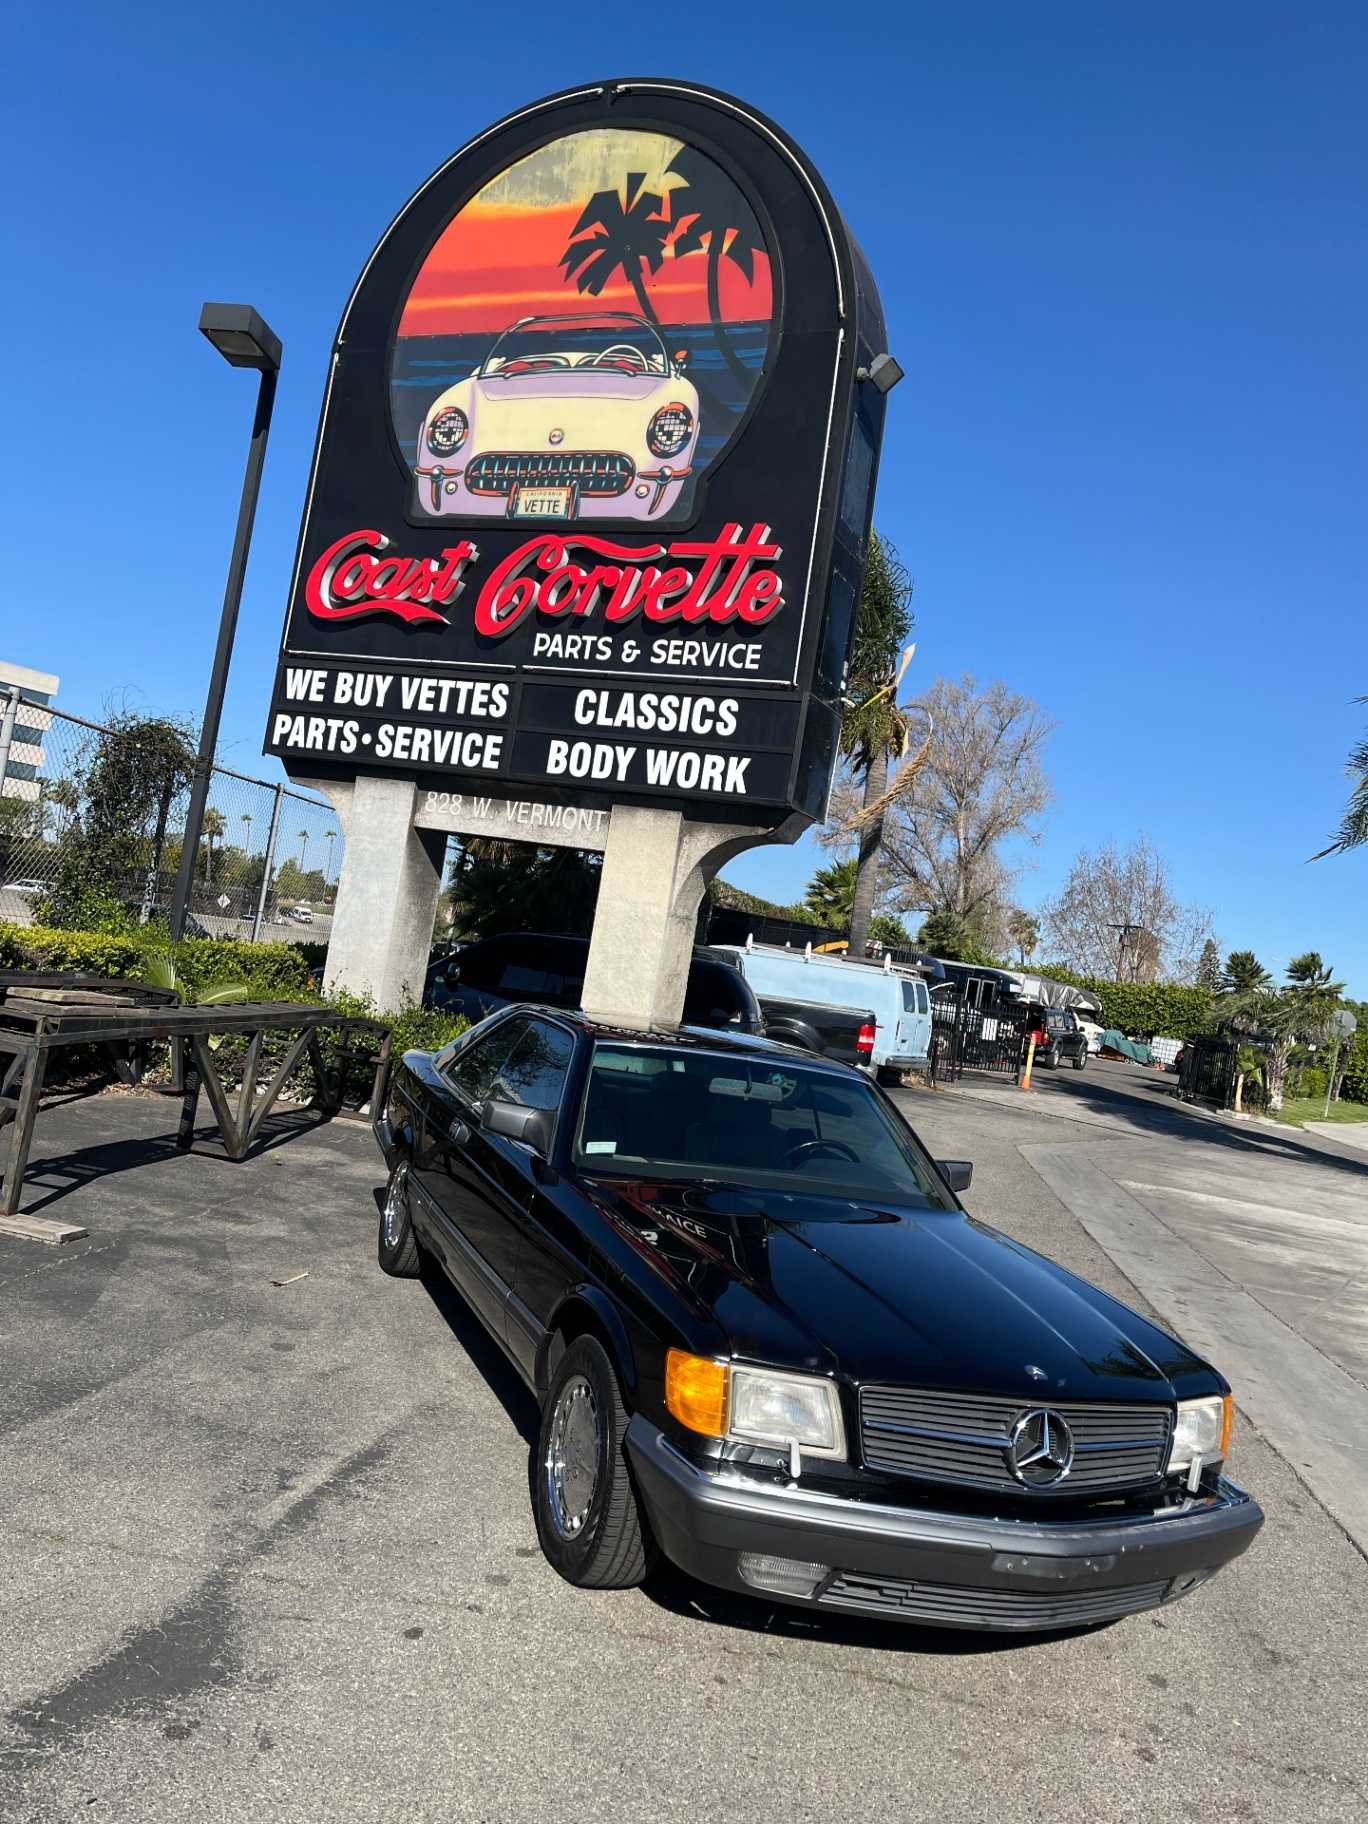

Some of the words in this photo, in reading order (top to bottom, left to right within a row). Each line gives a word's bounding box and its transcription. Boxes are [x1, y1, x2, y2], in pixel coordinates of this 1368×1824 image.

[523, 499, 561, 514] VETTE
[305, 529, 480, 625] Coast
[474, 521, 786, 639] Corvette
[533, 632, 613, 661] PARTS
[621, 638, 641, 663] &
[650, 638, 763, 670] SERVICE
[285, 668, 327, 702] WE
[333, 671, 394, 708] BUY
[400, 676, 510, 718] VETTES
[574, 689, 740, 737] CLASSICS
[546, 739, 637, 782] BODY
[645, 748, 753, 794] WORK
[424, 791, 463, 816] 828
[472, 796, 494, 820] W.
[505, 799, 608, 832] VERMONT
